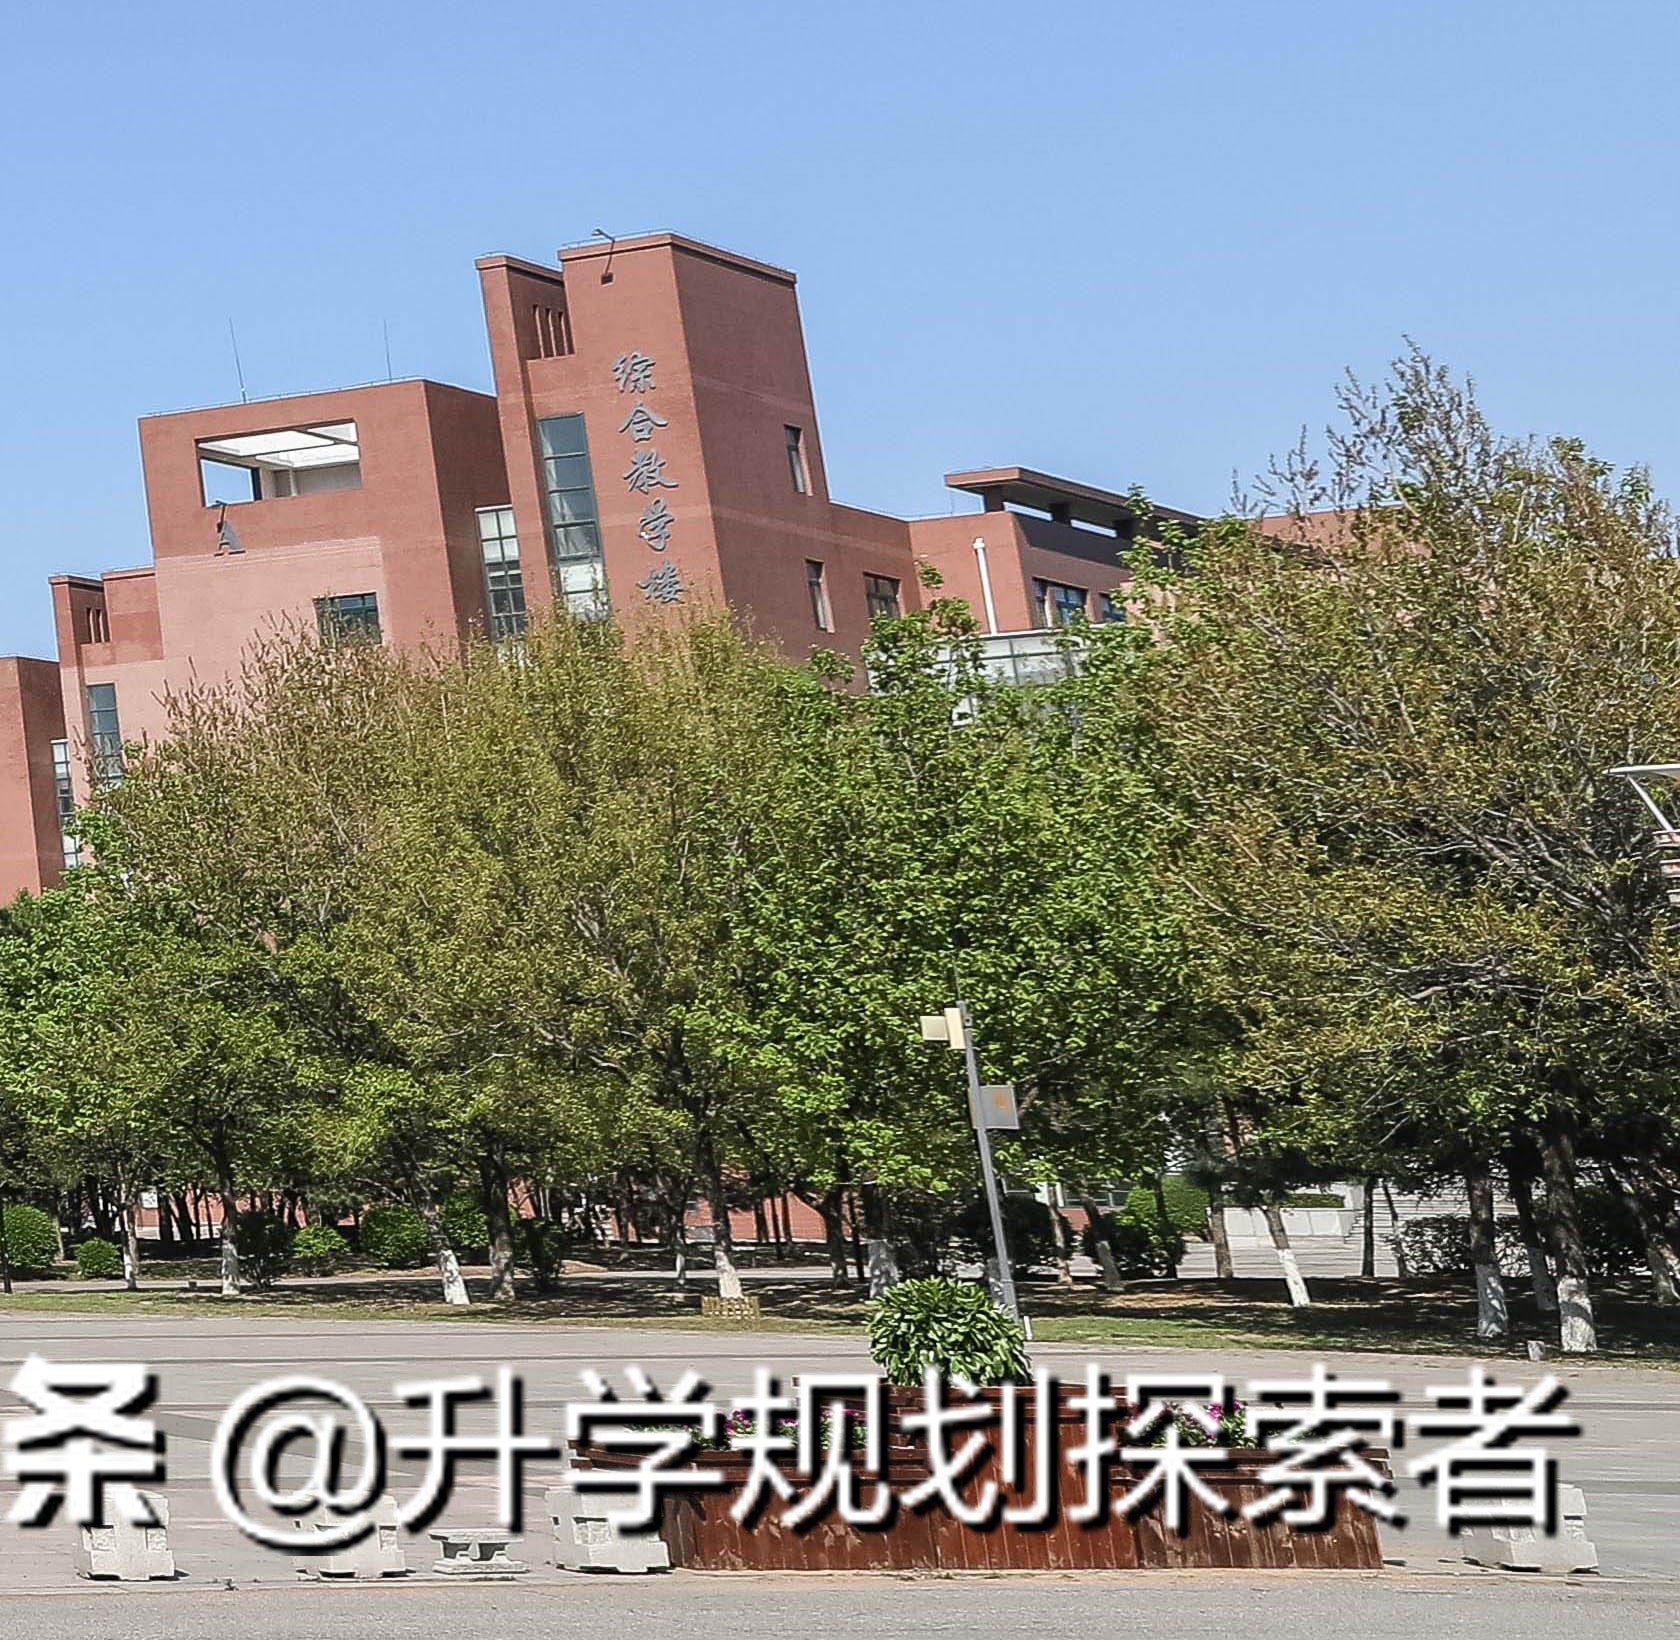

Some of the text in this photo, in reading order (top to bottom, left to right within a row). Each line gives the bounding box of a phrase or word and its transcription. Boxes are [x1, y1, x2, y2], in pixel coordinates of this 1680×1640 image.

[612, 351, 687, 601] 综合教学楼
